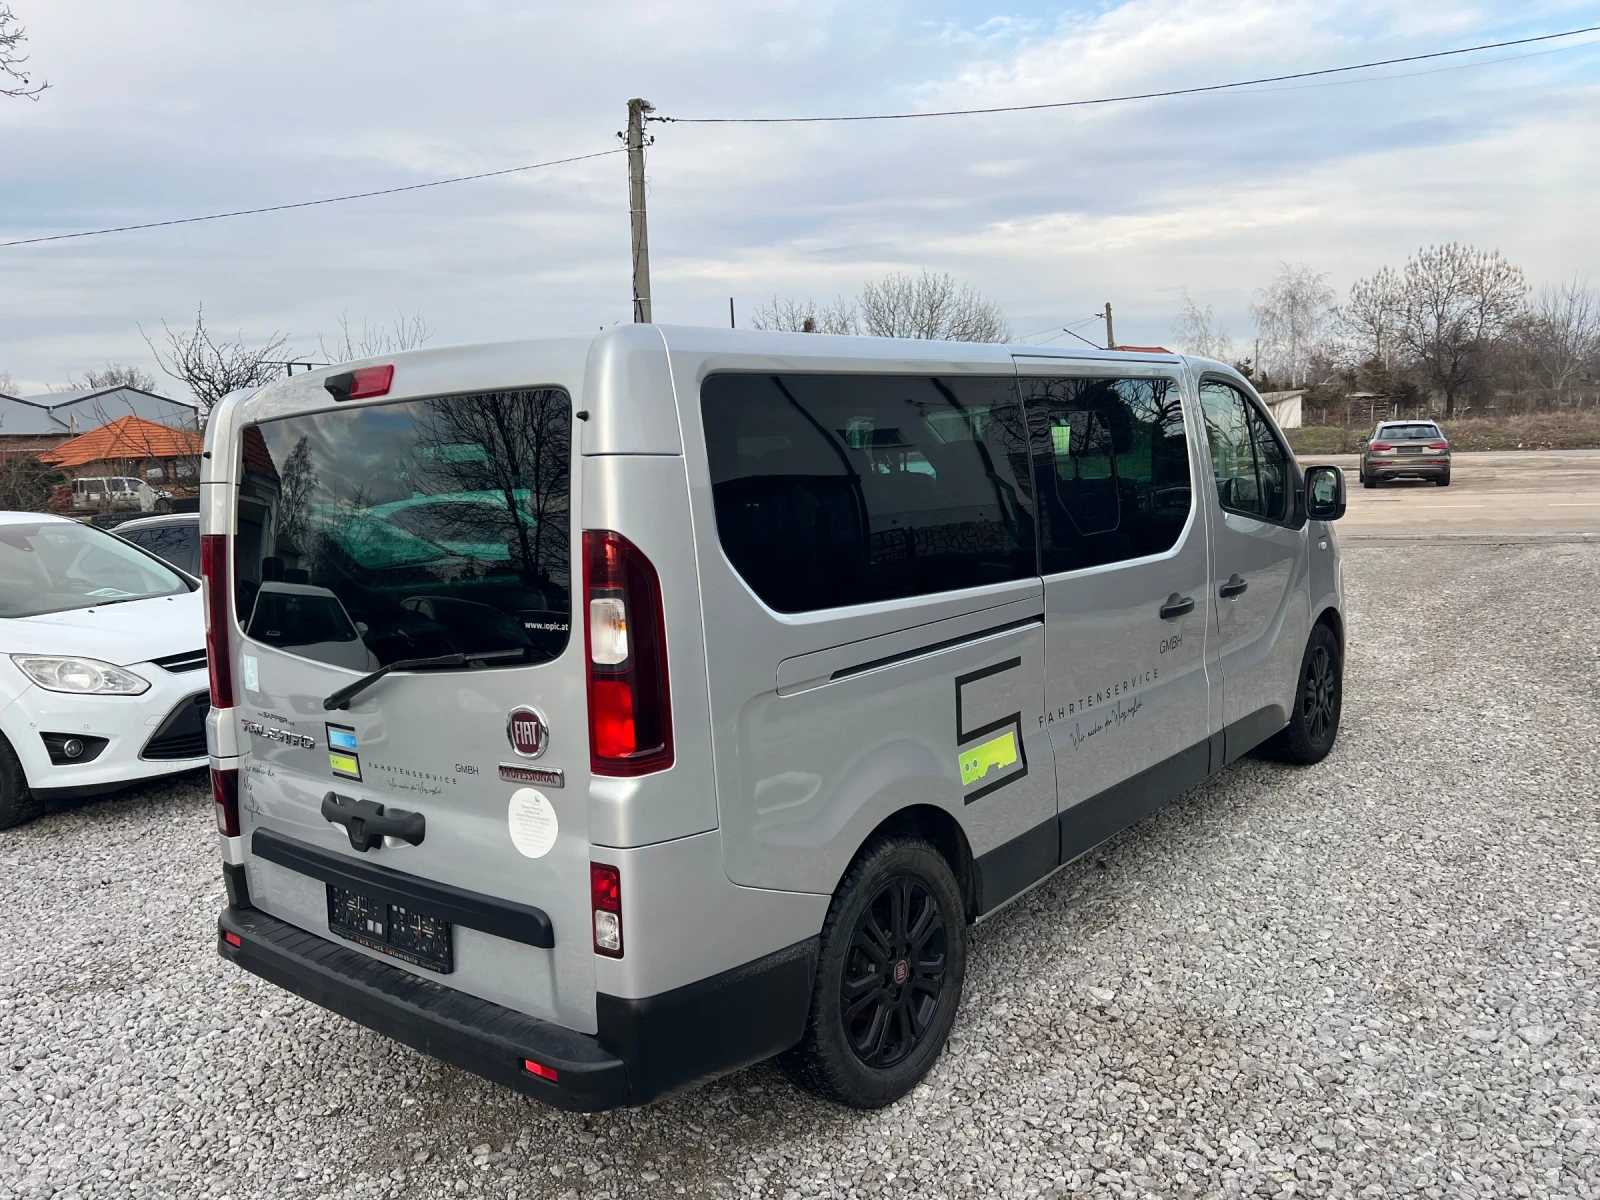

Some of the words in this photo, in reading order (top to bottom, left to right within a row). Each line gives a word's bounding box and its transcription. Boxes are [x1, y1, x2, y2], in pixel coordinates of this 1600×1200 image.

[1159, 634, 1183, 654] GMBH
[1038, 668, 1159, 728] FAHRTENSERVICE
[514, 720, 538, 745] FIAT
[368, 761, 458, 785] FAHRTENSERVICE
[454, 763, 480, 775] GMBH
[501, 768, 557, 784] PROFESSIONAL
